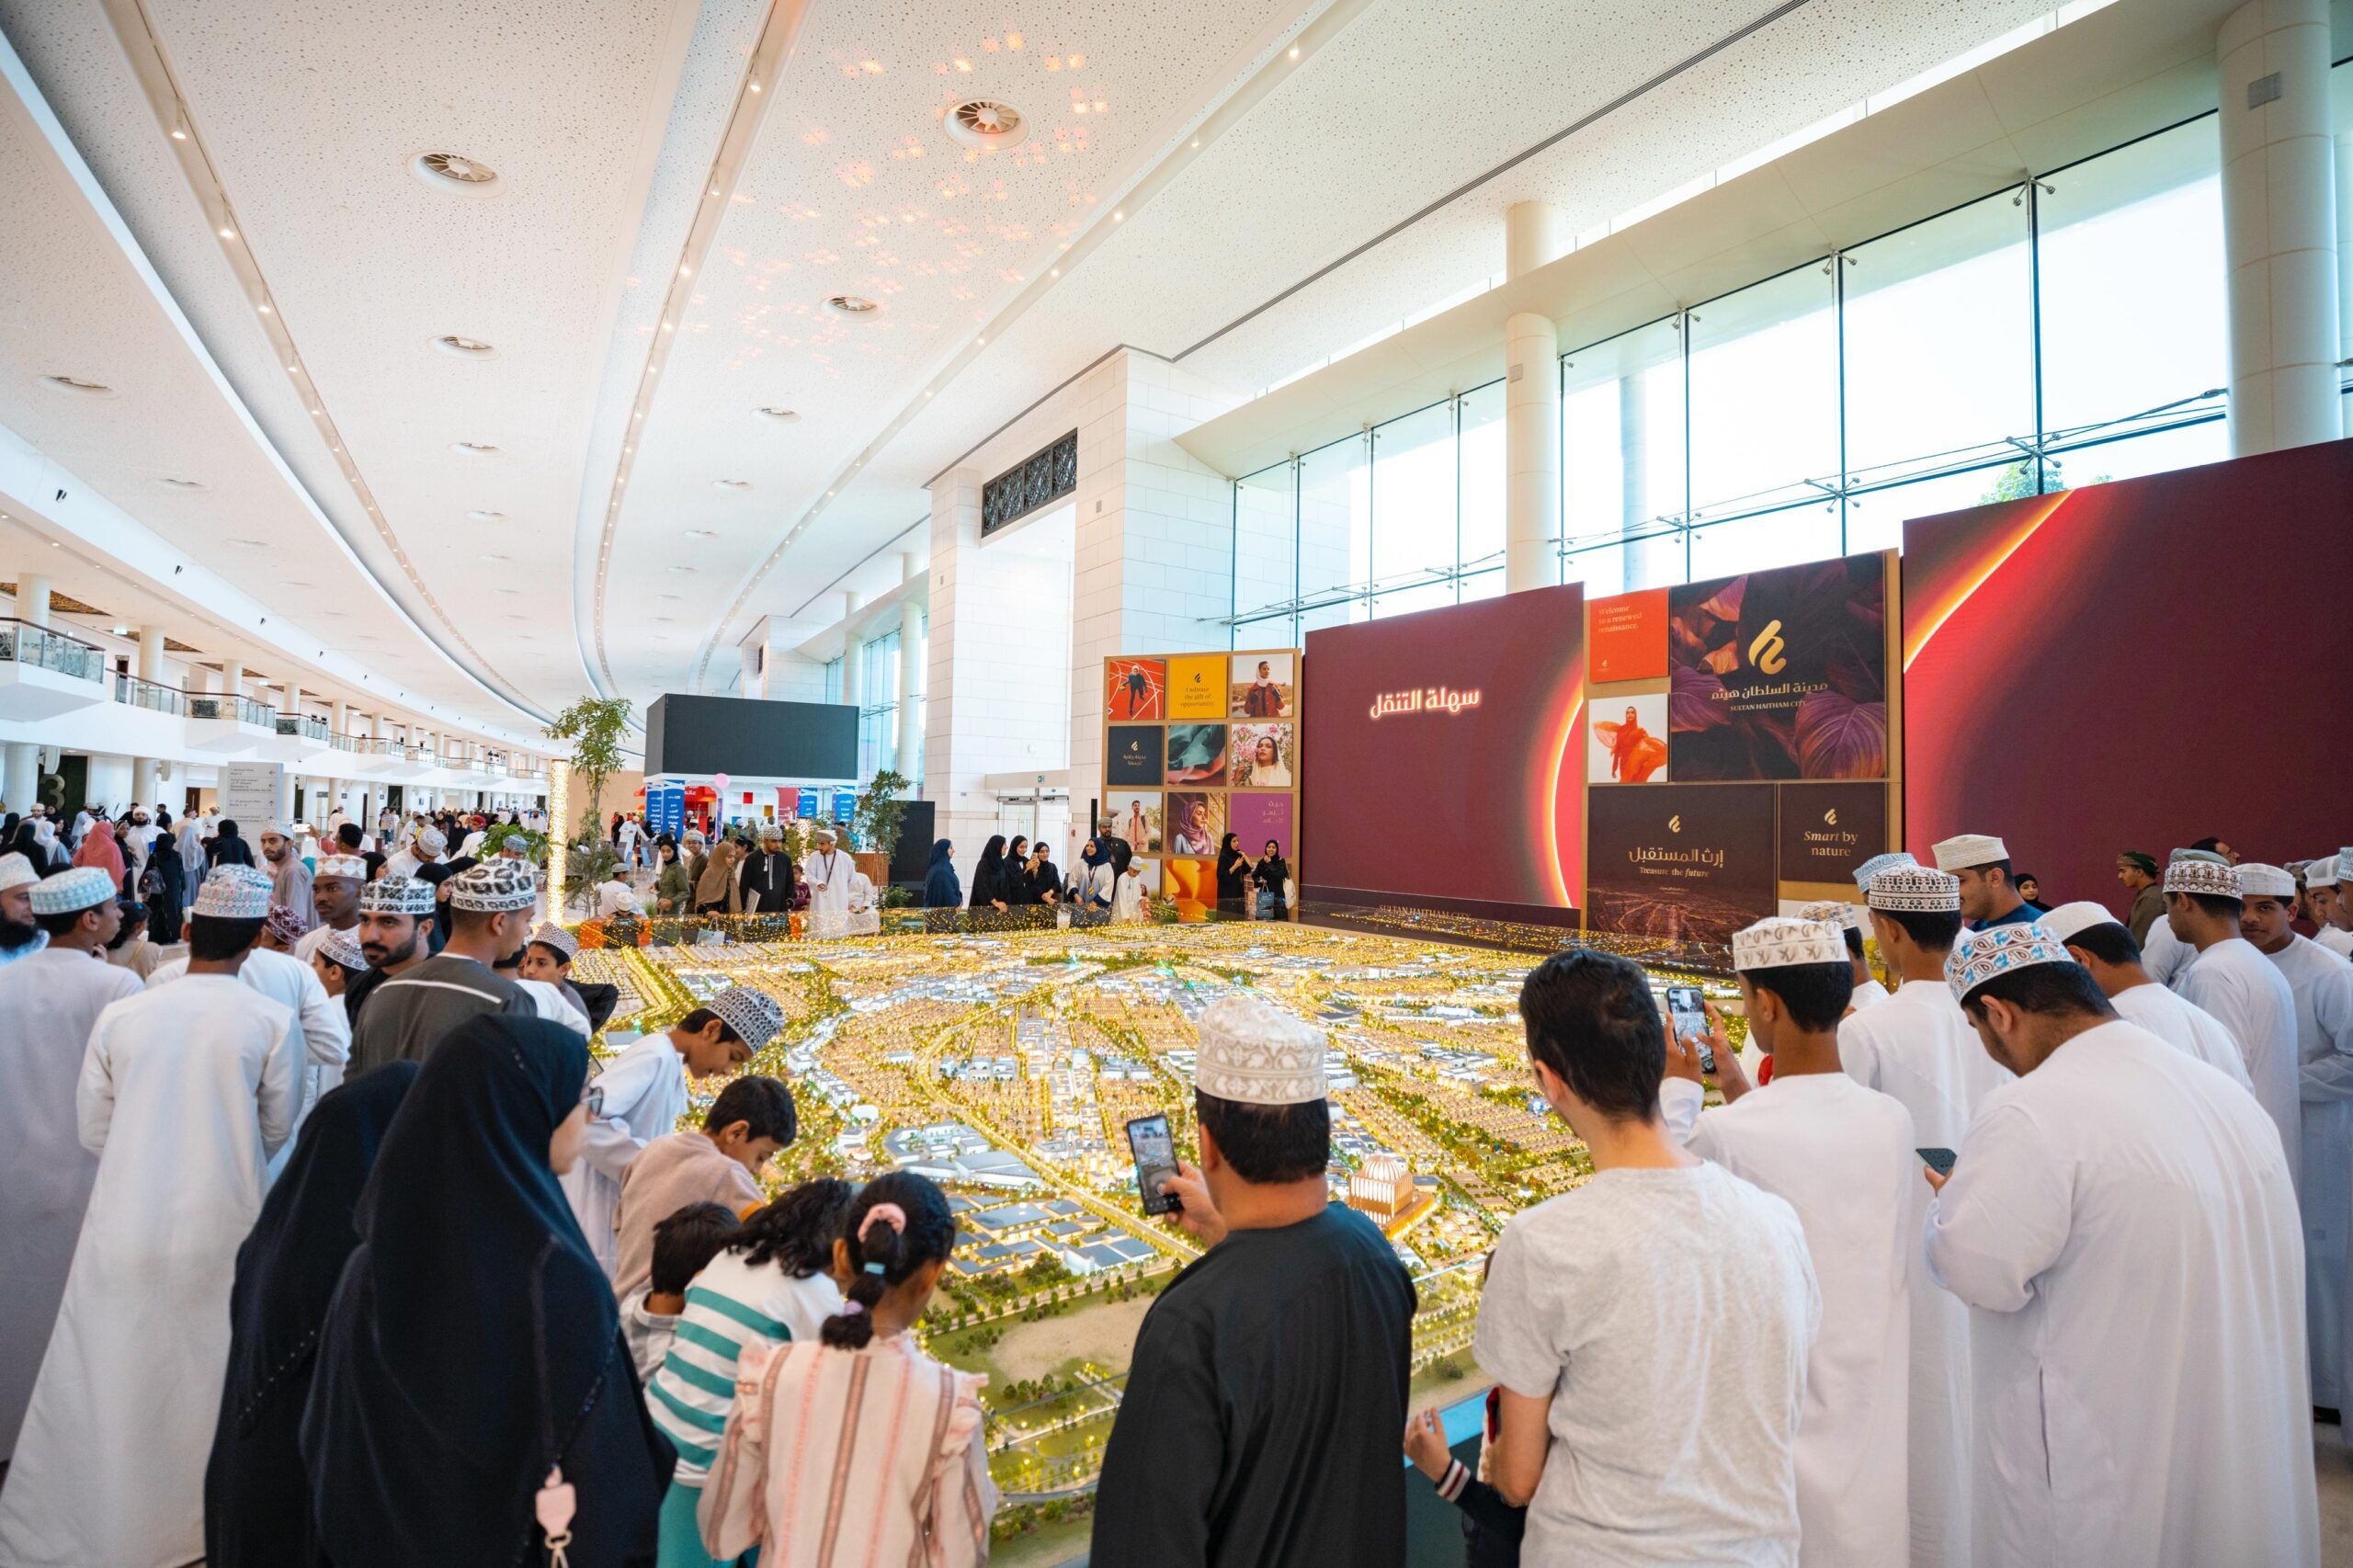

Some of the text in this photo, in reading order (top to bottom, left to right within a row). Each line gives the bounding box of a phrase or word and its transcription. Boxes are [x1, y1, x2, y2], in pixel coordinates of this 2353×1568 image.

[1598, 606, 1630, 615] Welcome
[1612, 611, 1642, 622] renewed
[1711, 682, 1828, 700] مدينة السلطان هيثم
[1370, 687, 1480, 718] سهلة التنقل
[1756, 701, 1790, 710] HAITHAM
[39, 774, 65, 811] 3
[389, 794, 401, 812] 4
[1803, 830, 1858, 845] Smart by
[1629, 846, 1724, 868] إرث المستقبل
[1811, 847, 1851, 857] nature
[1640, 867, 1710, 878] Treasure the future
[1379, 904, 1408, 915] SULTAN
[1409, 907, 1449, 918] HAITHAM
